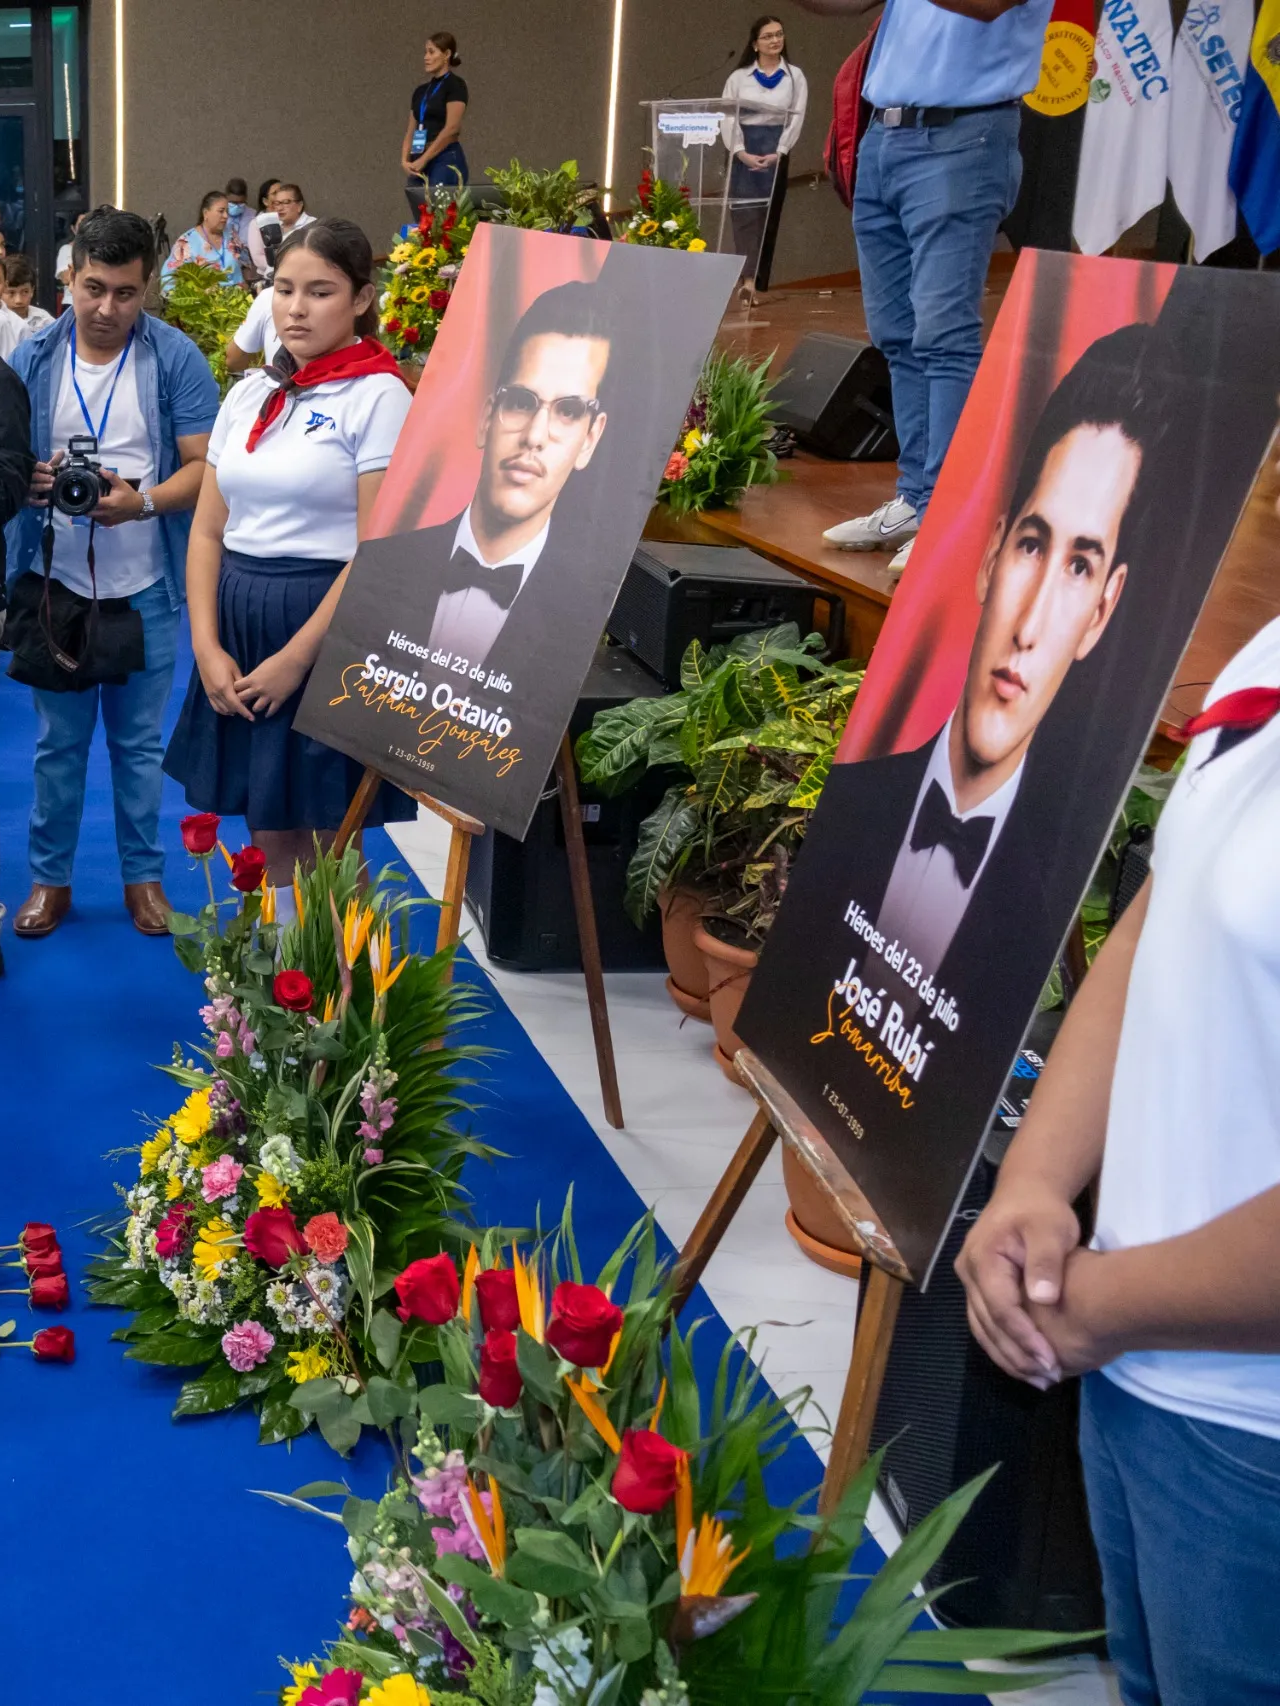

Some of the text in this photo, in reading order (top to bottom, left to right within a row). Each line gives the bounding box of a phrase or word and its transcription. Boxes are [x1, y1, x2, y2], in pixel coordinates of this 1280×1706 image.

[360, 653, 512, 738] Sergio Octavio
[386, 630, 512, 693] Héroes del 23 de julio
[329, 663, 523, 778] Saldaña González
[395, 748, 435, 772] 23-07-1959
[843, 900, 960, 1032] Héroes del 23 de julio
[810, 983, 915, 1109] Somarriba
[834, 958, 936, 1083] José Rubí
[828, 1090, 865, 1140] 23-07-1959
